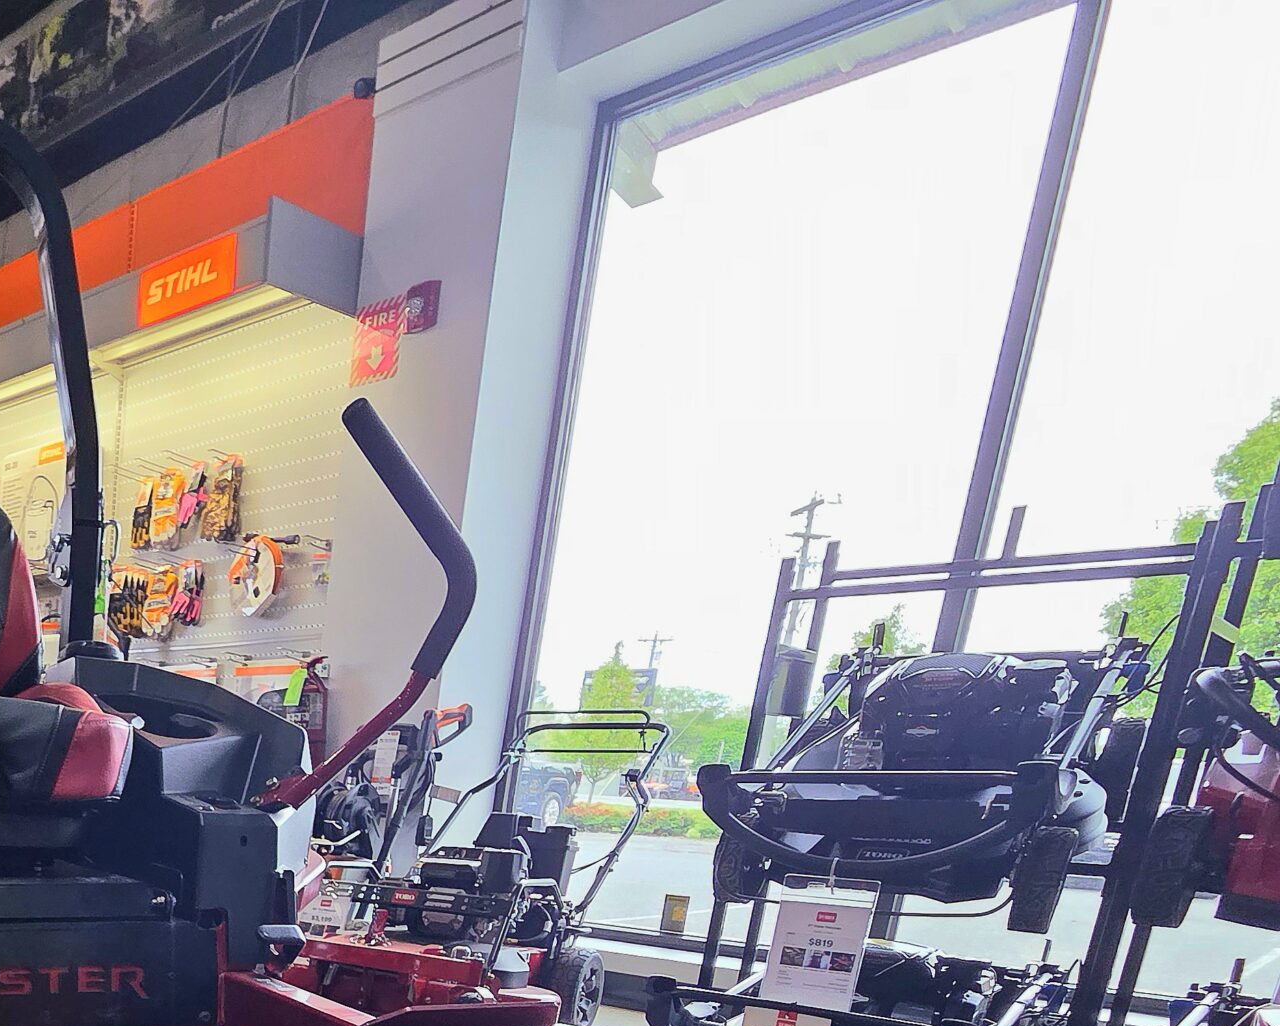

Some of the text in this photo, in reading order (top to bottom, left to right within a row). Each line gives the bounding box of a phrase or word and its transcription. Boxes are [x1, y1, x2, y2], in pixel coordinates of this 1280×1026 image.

[146, 259, 218, 305] STIHL
[364, 309, 397, 330] FIRE
[808, 937, 834, 949] $819
